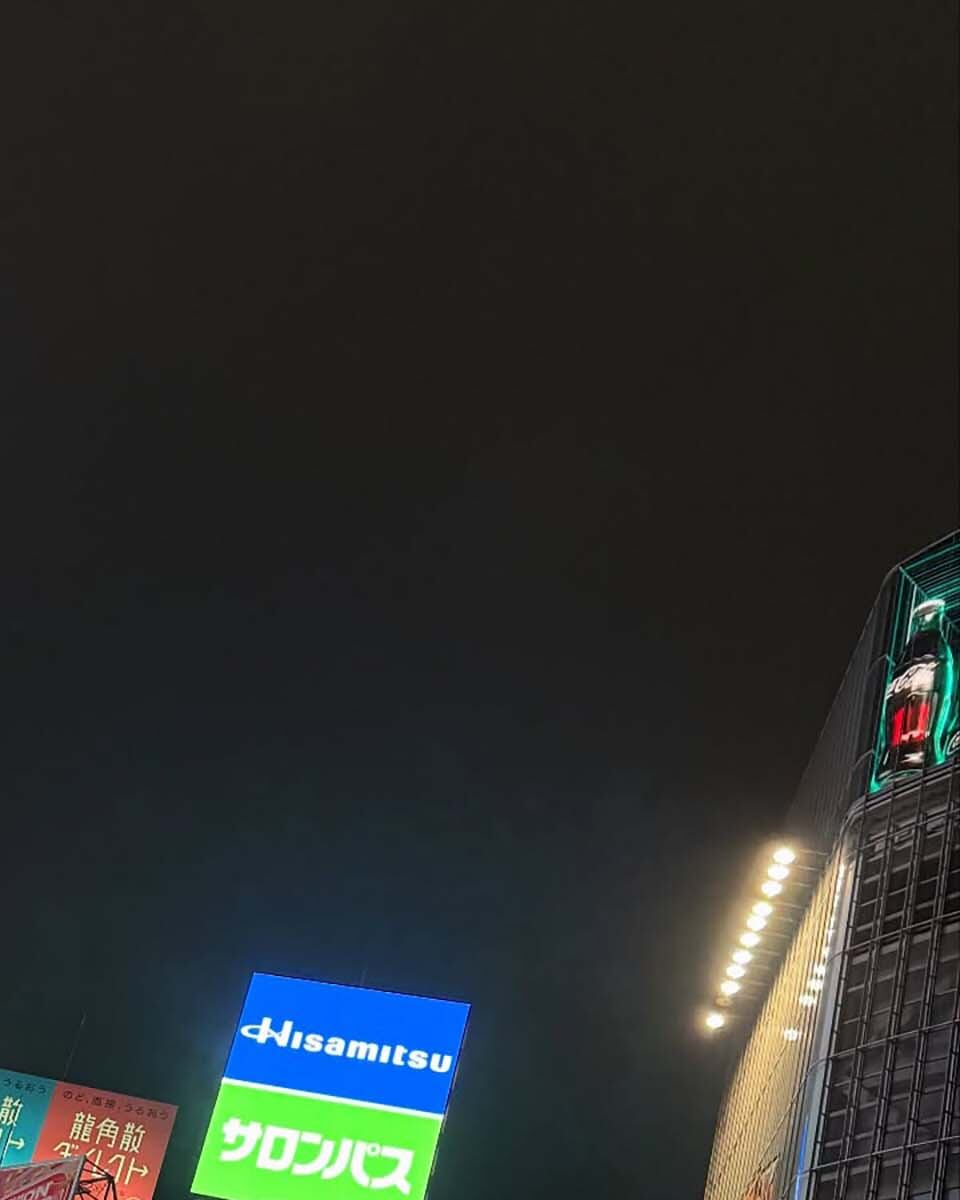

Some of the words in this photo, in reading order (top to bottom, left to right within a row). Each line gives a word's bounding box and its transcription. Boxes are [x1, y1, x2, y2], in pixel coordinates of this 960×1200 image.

[241, 1016, 452, 1074] Hisamitsu
[69, 1111, 146, 1154] 龍角散
[220, 1117, 415, 1196] サロンパス
